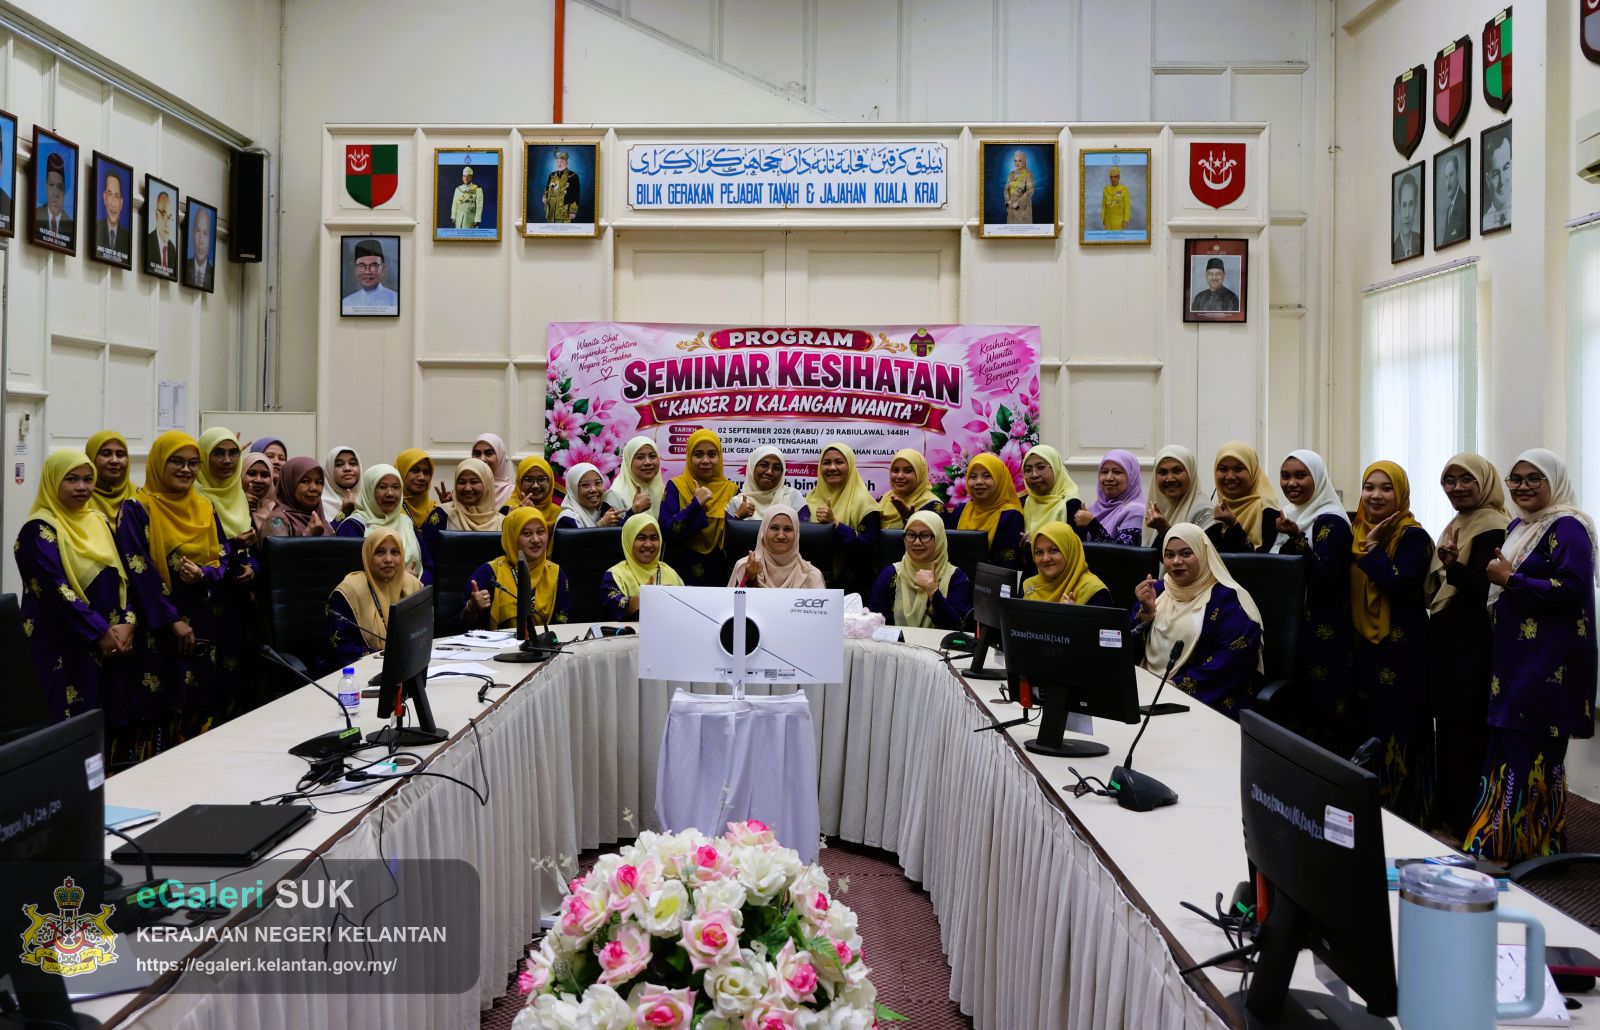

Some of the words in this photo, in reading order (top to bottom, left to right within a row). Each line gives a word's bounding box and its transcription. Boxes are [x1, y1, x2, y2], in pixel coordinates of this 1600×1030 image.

[637, 183, 662, 204] BILIK
[668, 183, 714, 204] GERAKAN
[721, 183, 764, 204] PEJABAT
[768, 183, 799, 204] TANAH
[806, 183, 814, 204] &
[820, 183, 866, 204] JAJAHAN
[875, 183, 907, 204] KUALA
[915, 183, 938, 204] KRAI
[729, 331, 853, 347] PROGRAM
[980, 337, 1016, 355] Kesihatan
[986, 348, 1013, 364] Wanita
[979, 358, 1021, 376] Keutamaan
[623, 352, 770, 400] SEMINAR
[778, 351, 961, 404] KESIHATAN
[985, 368, 1019, 385] Bersama
[733, 395, 752, 412] DI
[756, 395, 846, 414] KALANGAN
[758, 437, 776, 445] 12.30
[794, 479, 817, 490] bint
[794, 598, 829, 609] acer
